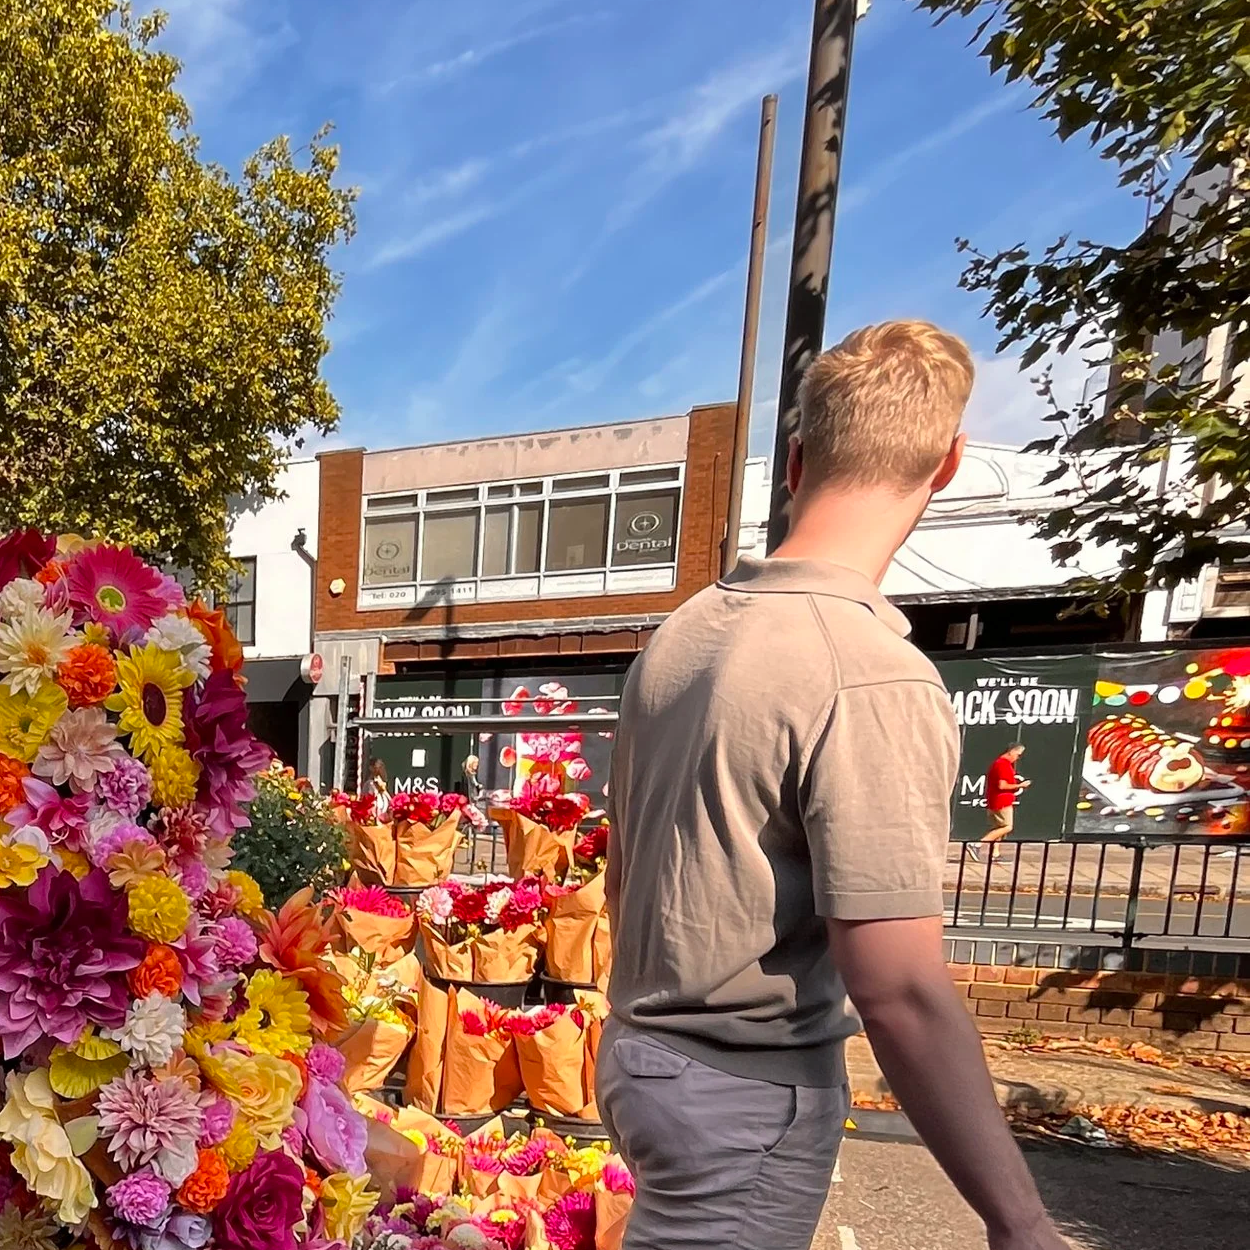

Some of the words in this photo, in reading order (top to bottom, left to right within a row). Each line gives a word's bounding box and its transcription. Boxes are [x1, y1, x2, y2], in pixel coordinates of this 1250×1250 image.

[616, 537, 672, 552] Dental
[389, 591, 407, 599] 020
[976, 677, 1016, 688] WE'LL
[1019, 676, 1039, 687] BE
[953, 690, 1000, 725] ACK
[1006, 689, 1078, 725] SOON
[394, 777, 439, 795] M&S
